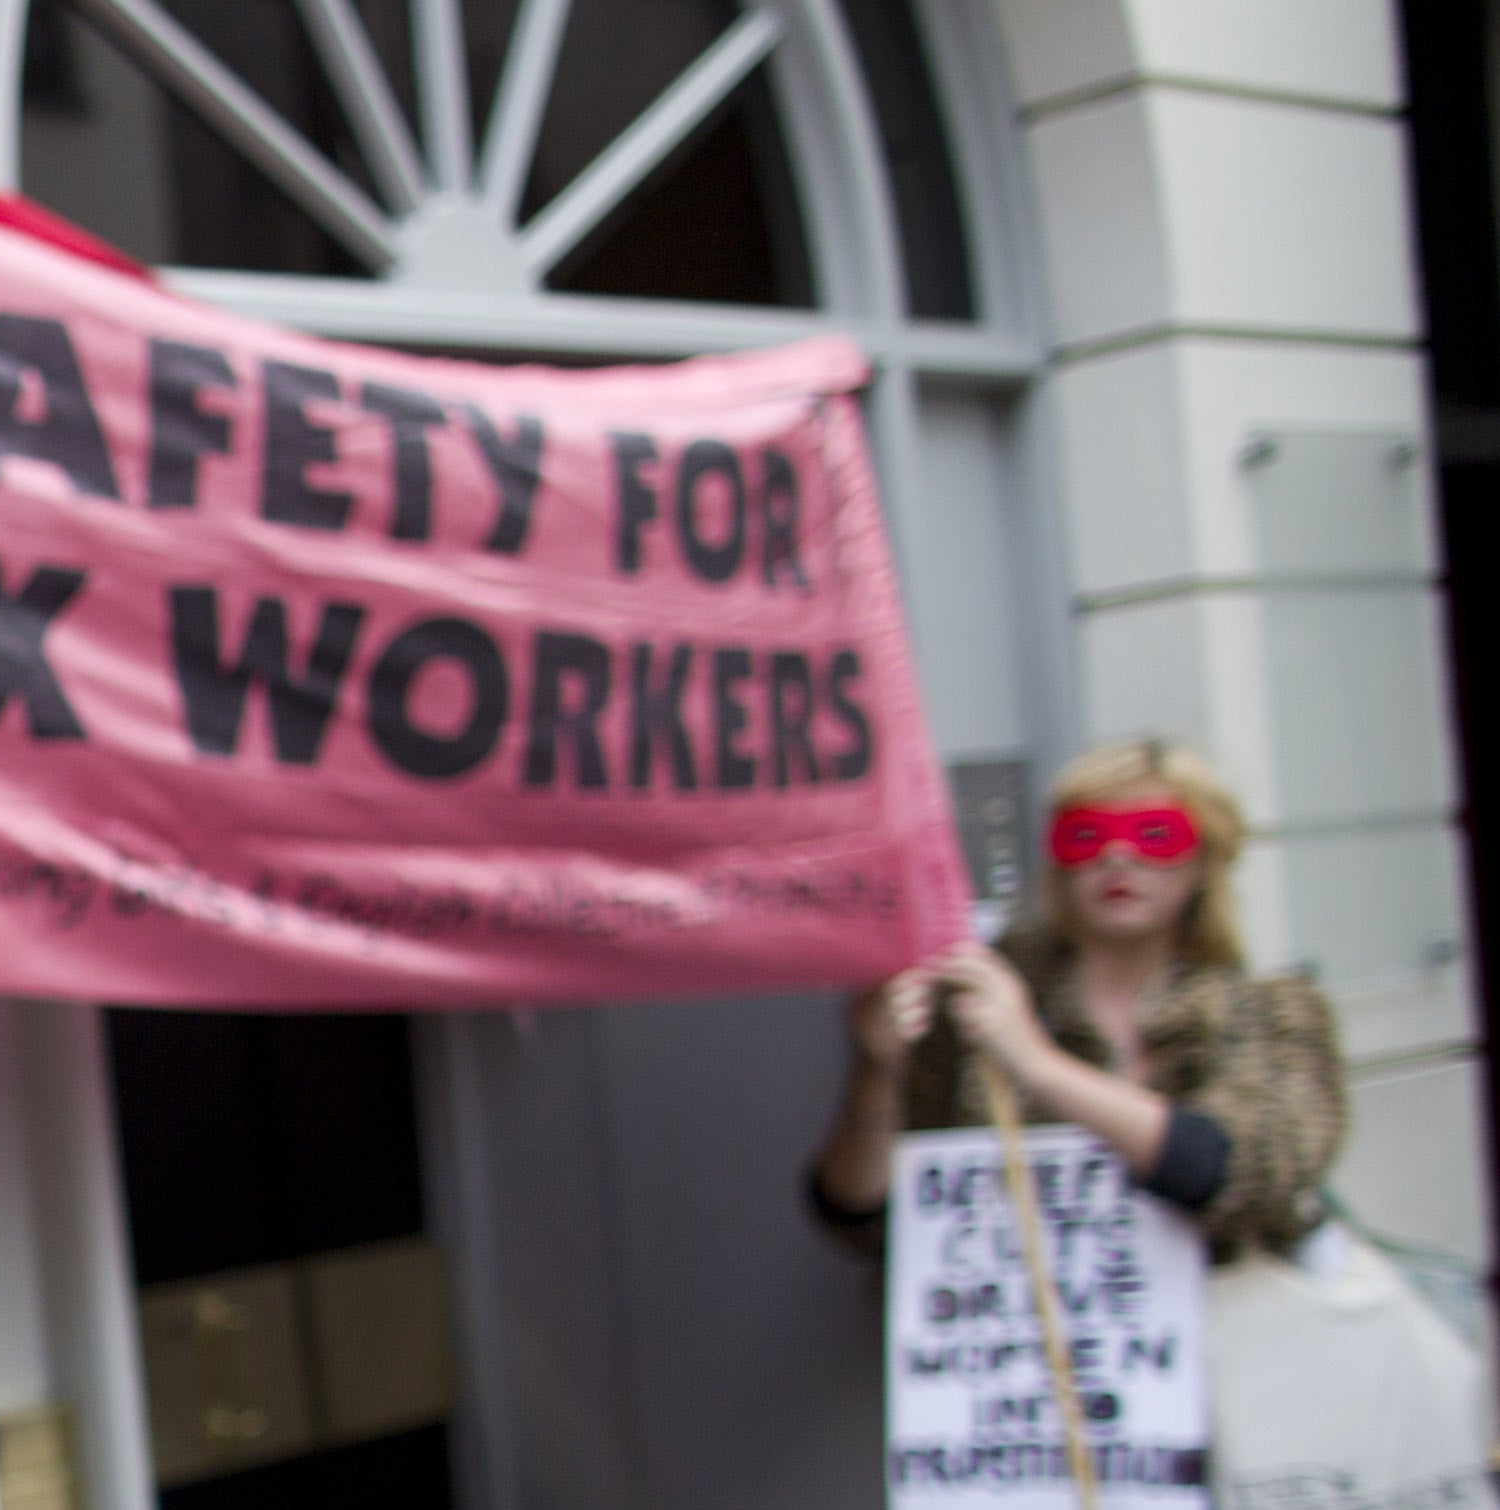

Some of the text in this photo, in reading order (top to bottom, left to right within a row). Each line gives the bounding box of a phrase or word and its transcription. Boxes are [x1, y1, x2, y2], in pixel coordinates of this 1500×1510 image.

[610, 429, 810, 596] FOR
[164, 583, 877, 792] WORKERS
[928, 1280, 1147, 1328] DRVE
